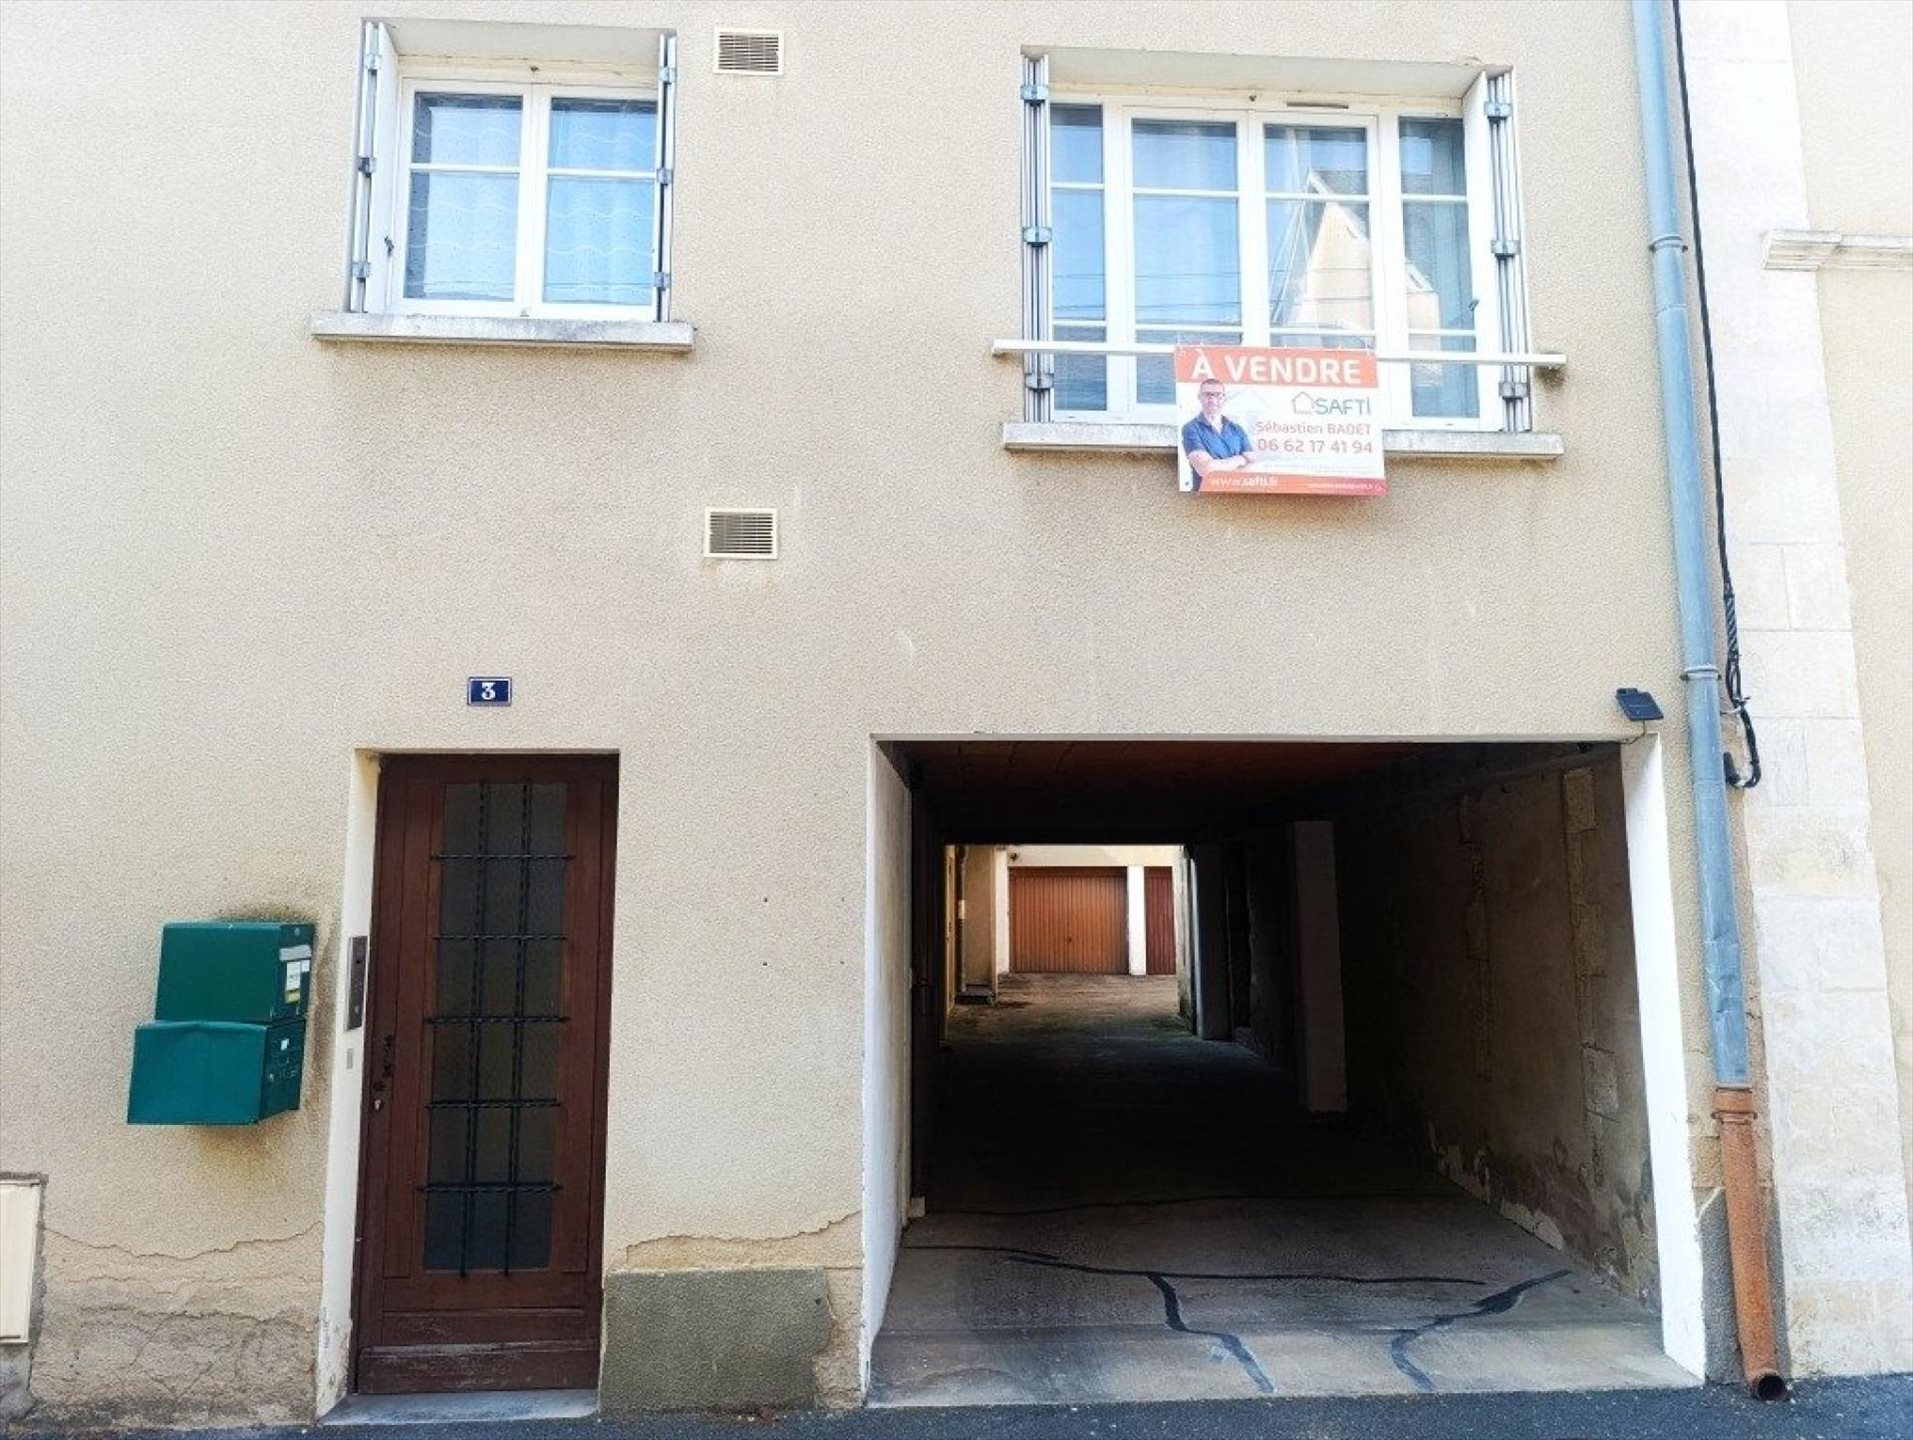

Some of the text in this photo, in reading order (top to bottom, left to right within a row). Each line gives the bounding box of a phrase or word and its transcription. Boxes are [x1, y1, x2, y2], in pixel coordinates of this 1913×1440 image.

[1192, 348, 1361, 384] À VENDRE
[1316, 396, 1372, 415] SAFTI
[1255, 421, 1323, 435] Sébastien
[1257, 438, 1373, 455] 06 62 17 41 94
[481, 682, 496, 700] 3
